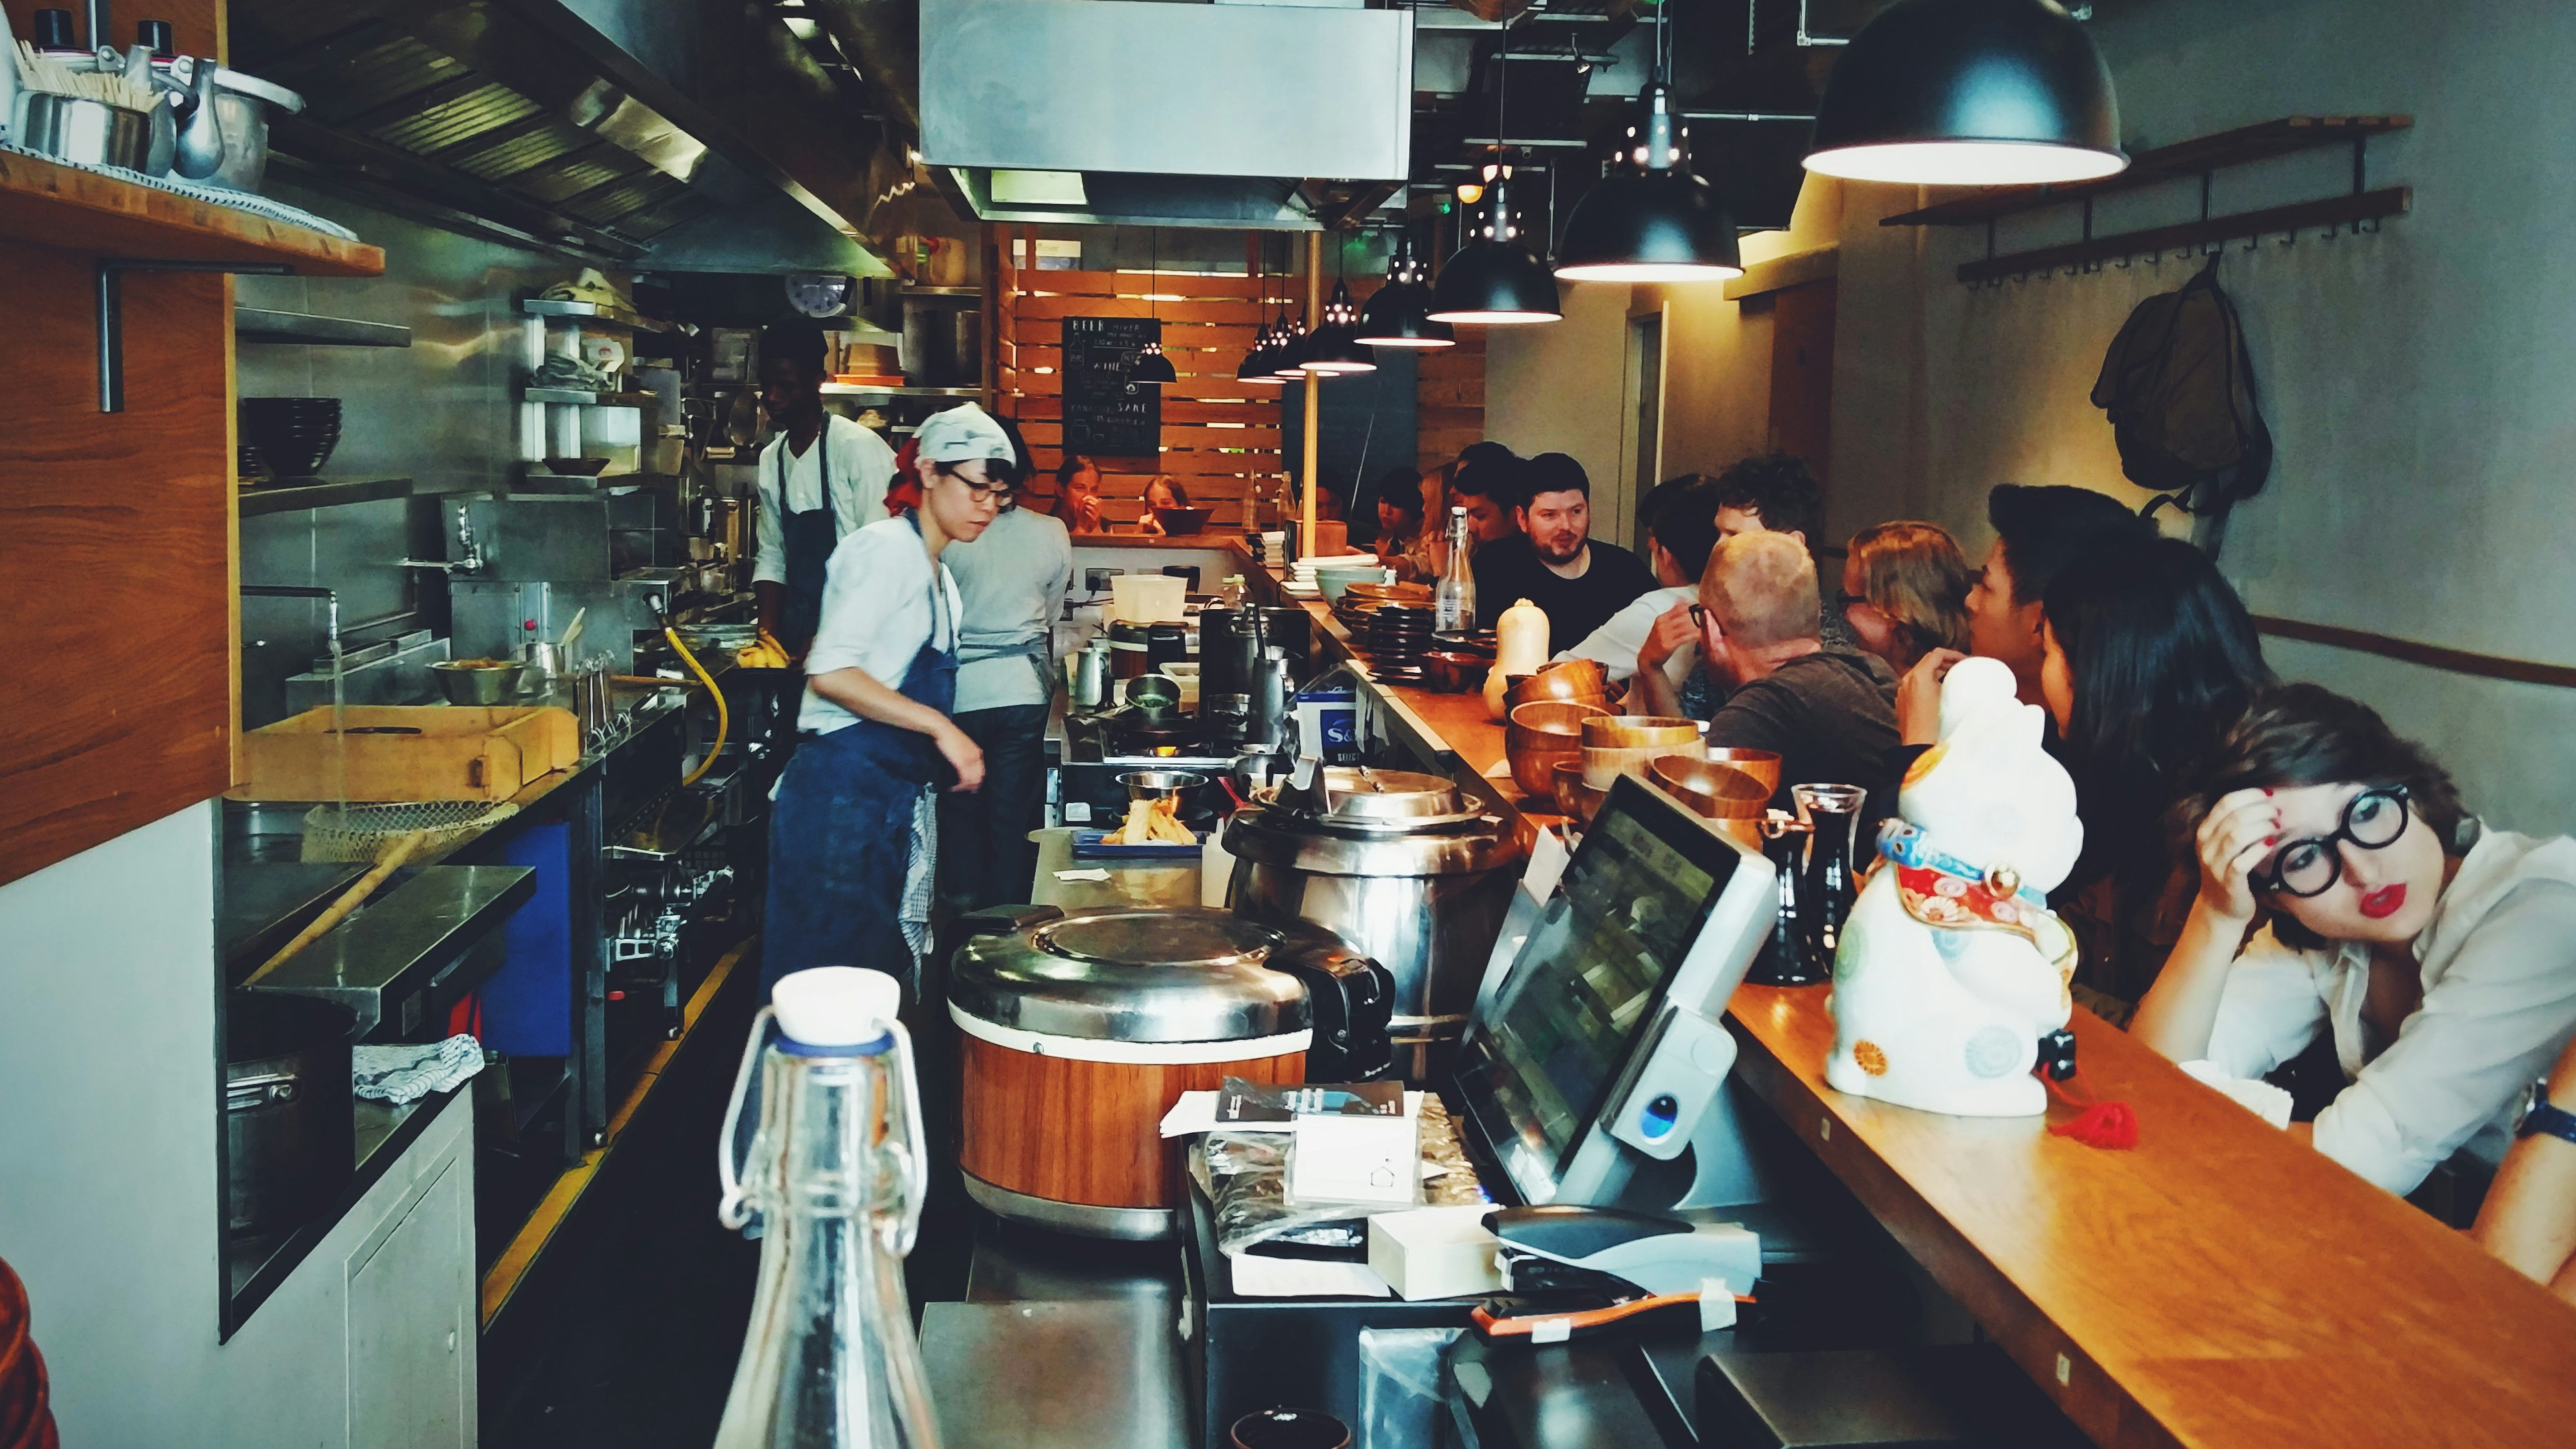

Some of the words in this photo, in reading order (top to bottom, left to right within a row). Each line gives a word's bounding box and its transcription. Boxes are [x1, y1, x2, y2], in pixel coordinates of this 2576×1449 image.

[1073, 320, 1104, 331] BEER
[1093, 362, 1120, 372] WINE
[1337, 753, 1360, 762] SELECT
